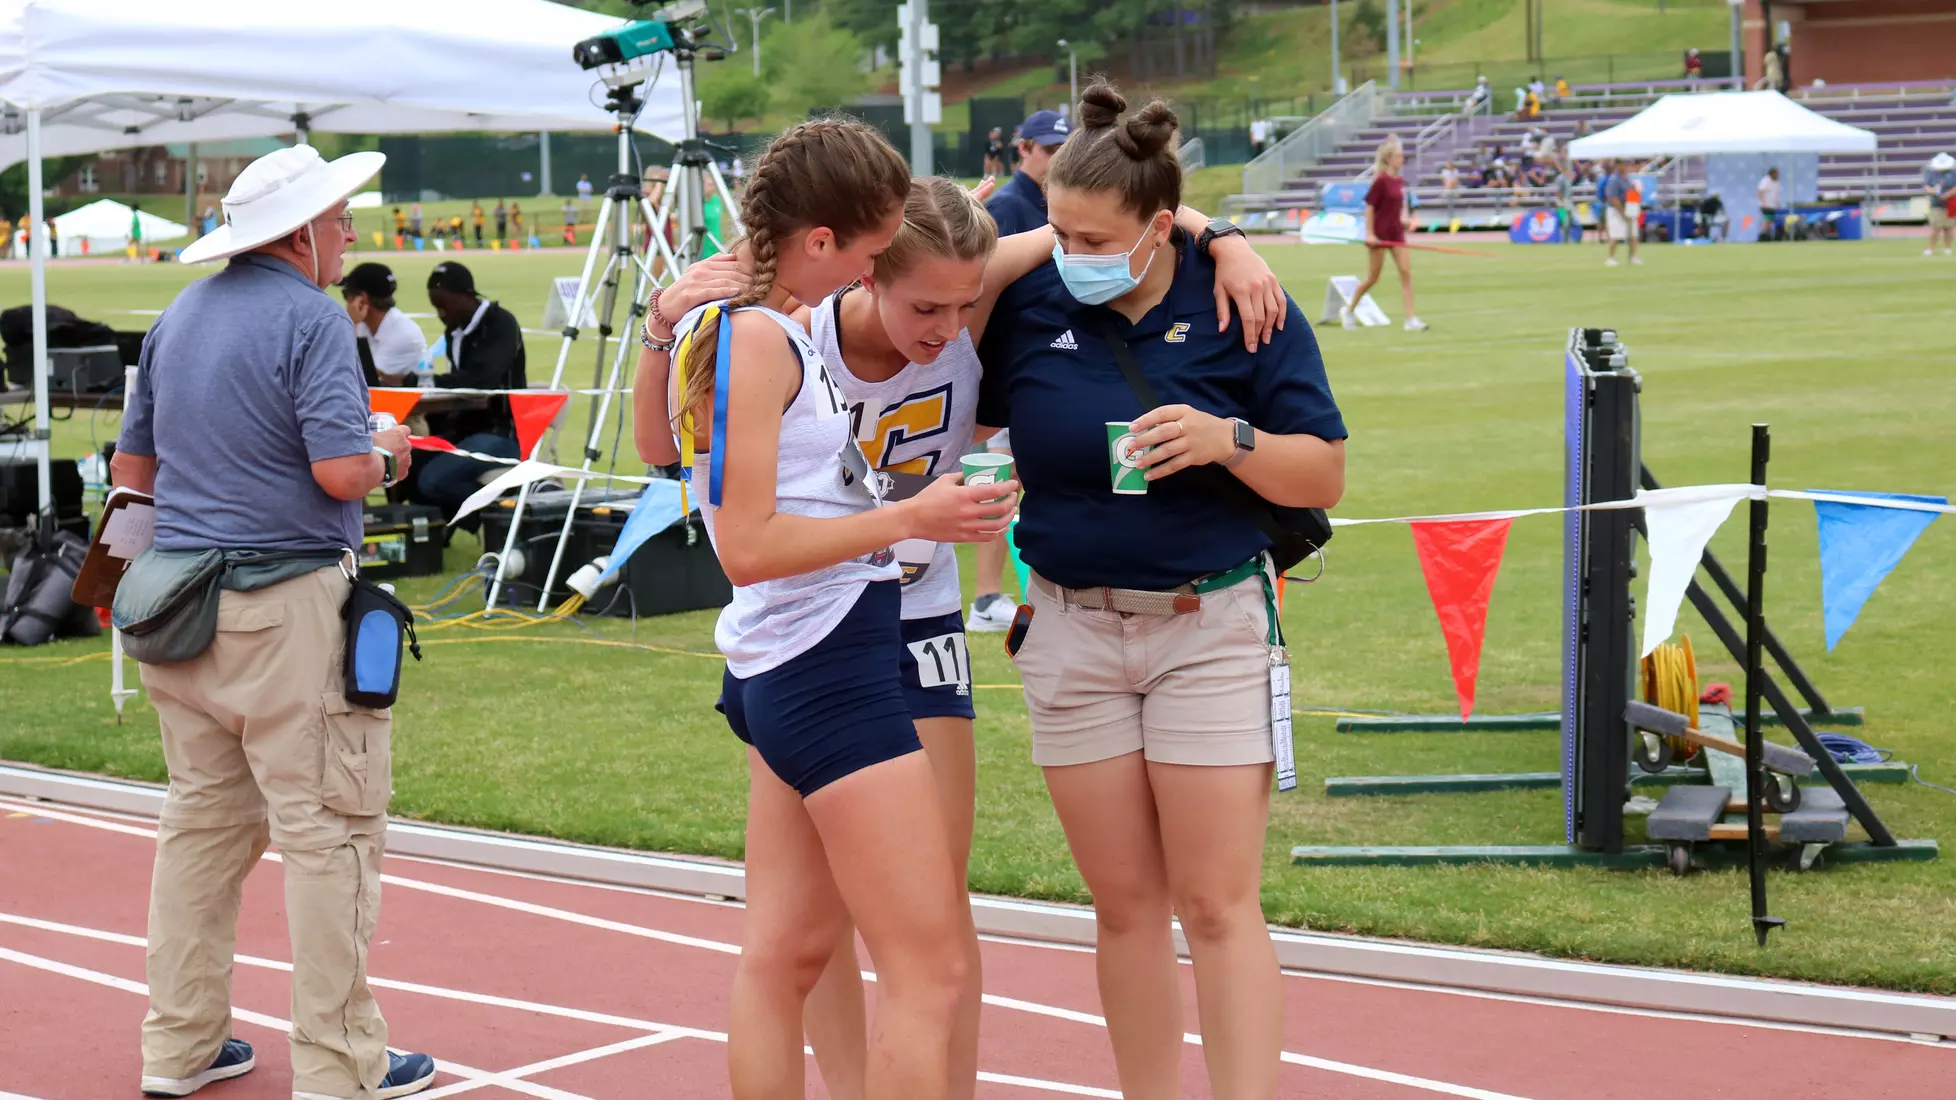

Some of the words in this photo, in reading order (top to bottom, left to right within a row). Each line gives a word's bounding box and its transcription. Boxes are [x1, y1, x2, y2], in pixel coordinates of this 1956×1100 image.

[1164, 322, 1191, 342] C
[1050, 342, 1079, 350] adidas
[922, 636, 961, 682] 11
